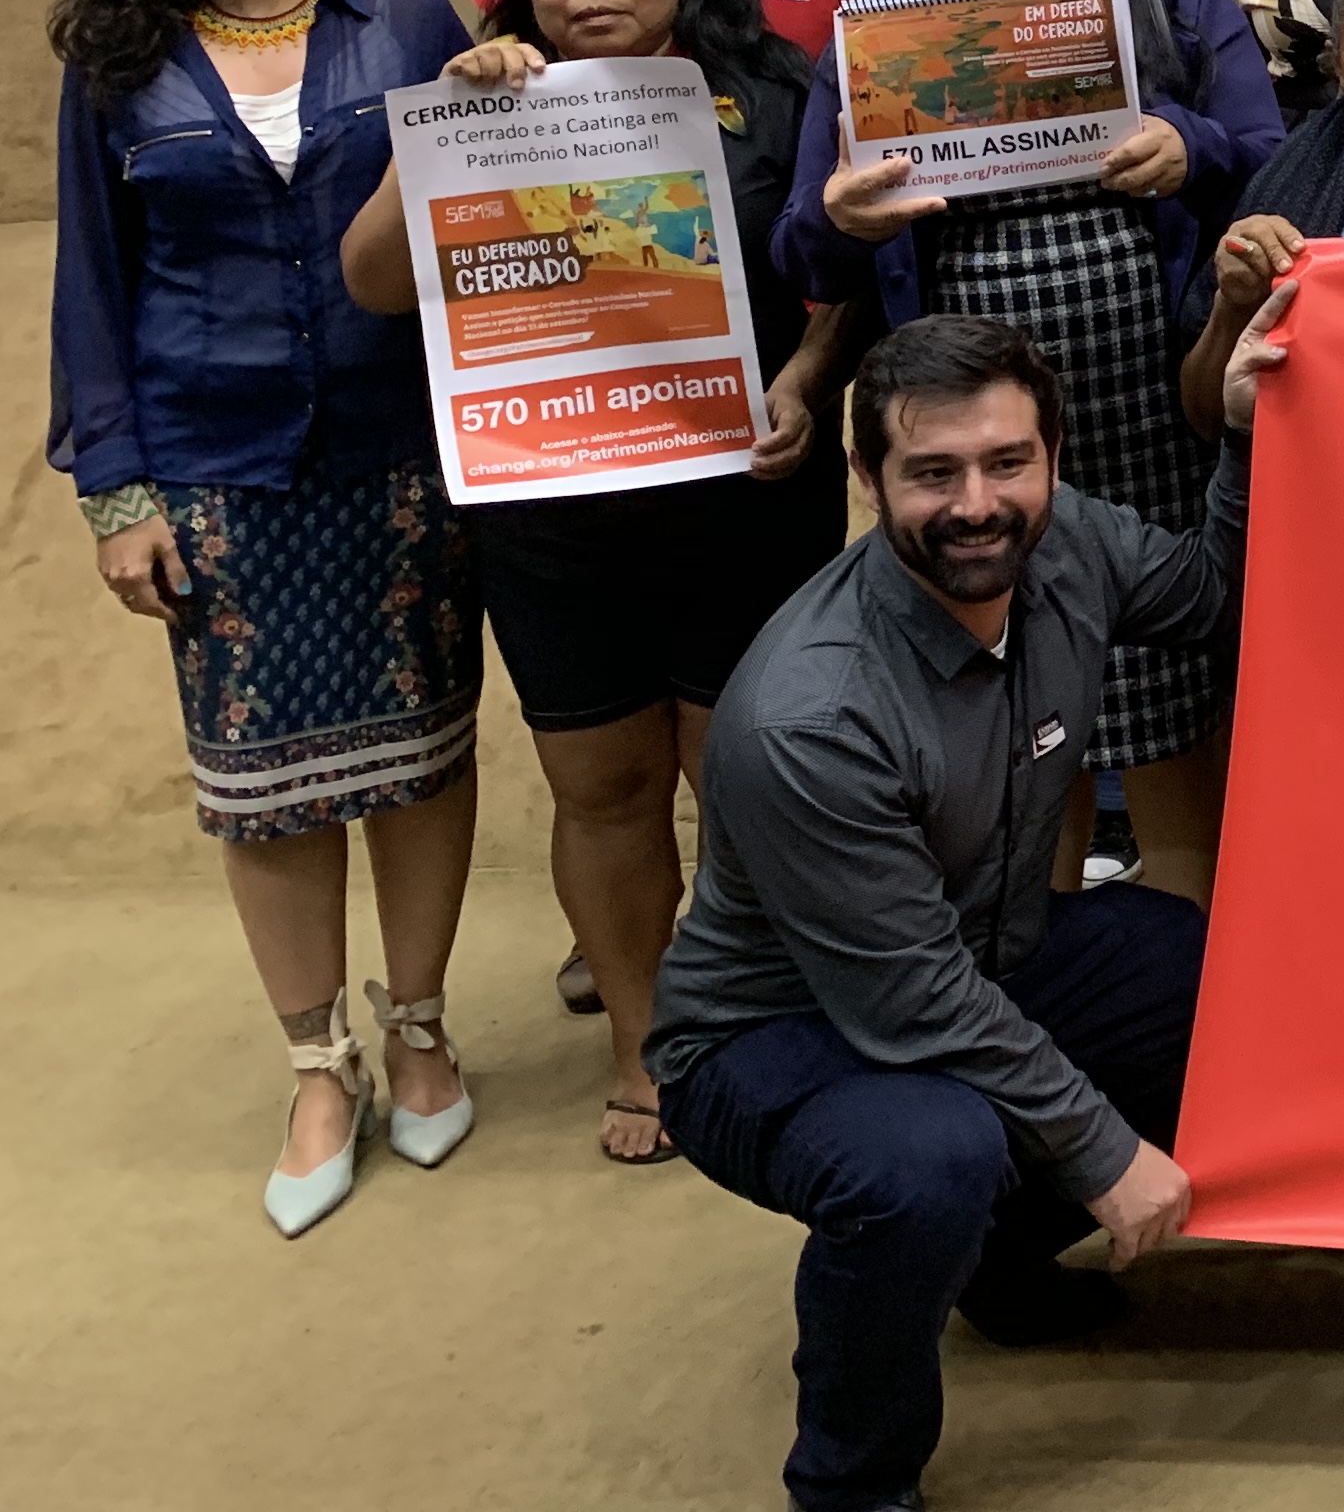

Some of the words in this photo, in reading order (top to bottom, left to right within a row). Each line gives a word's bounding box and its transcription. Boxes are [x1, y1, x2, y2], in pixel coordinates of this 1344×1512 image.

[1026, 3, 1046, 23] EM
[1050, 0, 1102, 20] DEFESA
[1013, 26, 1034, 44] DO
[1038, 19, 1104, 40] CERRADO
[403, 95, 522, 127] CERRADO:
[528, 94, 589, 111] vamos
[594, 84, 697, 104] transformar
[437, 135, 449, 148] o
[455, 123, 528, 146] Cerrado
[535, 125, 545, 136] e
[551, 124, 561, 135] a
[566, 112, 646, 133] Caatinga
[651, 110, 679, 124] em
[932, 141, 976, 162] MIL
[982, 122, 1109, 157] ASSINAM:
[466, 144, 568, 168] Patrimônio
[573, 134, 659, 158] Nacional!
[451, 249, 472, 266] EU
[478, 239, 550, 263] DEFENDO
[557, 236, 568, 253] O
[456, 256, 580, 295] CERRADO
[462, 397, 528, 433] 570
[539, 385, 596, 421] mil
[607, 373, 739, 413] apoiam
[467, 425, 750, 478] change.org/PatrimonioNacional
[540, 437, 579, 451] Acesse
[582, 437, 588, 445] o
